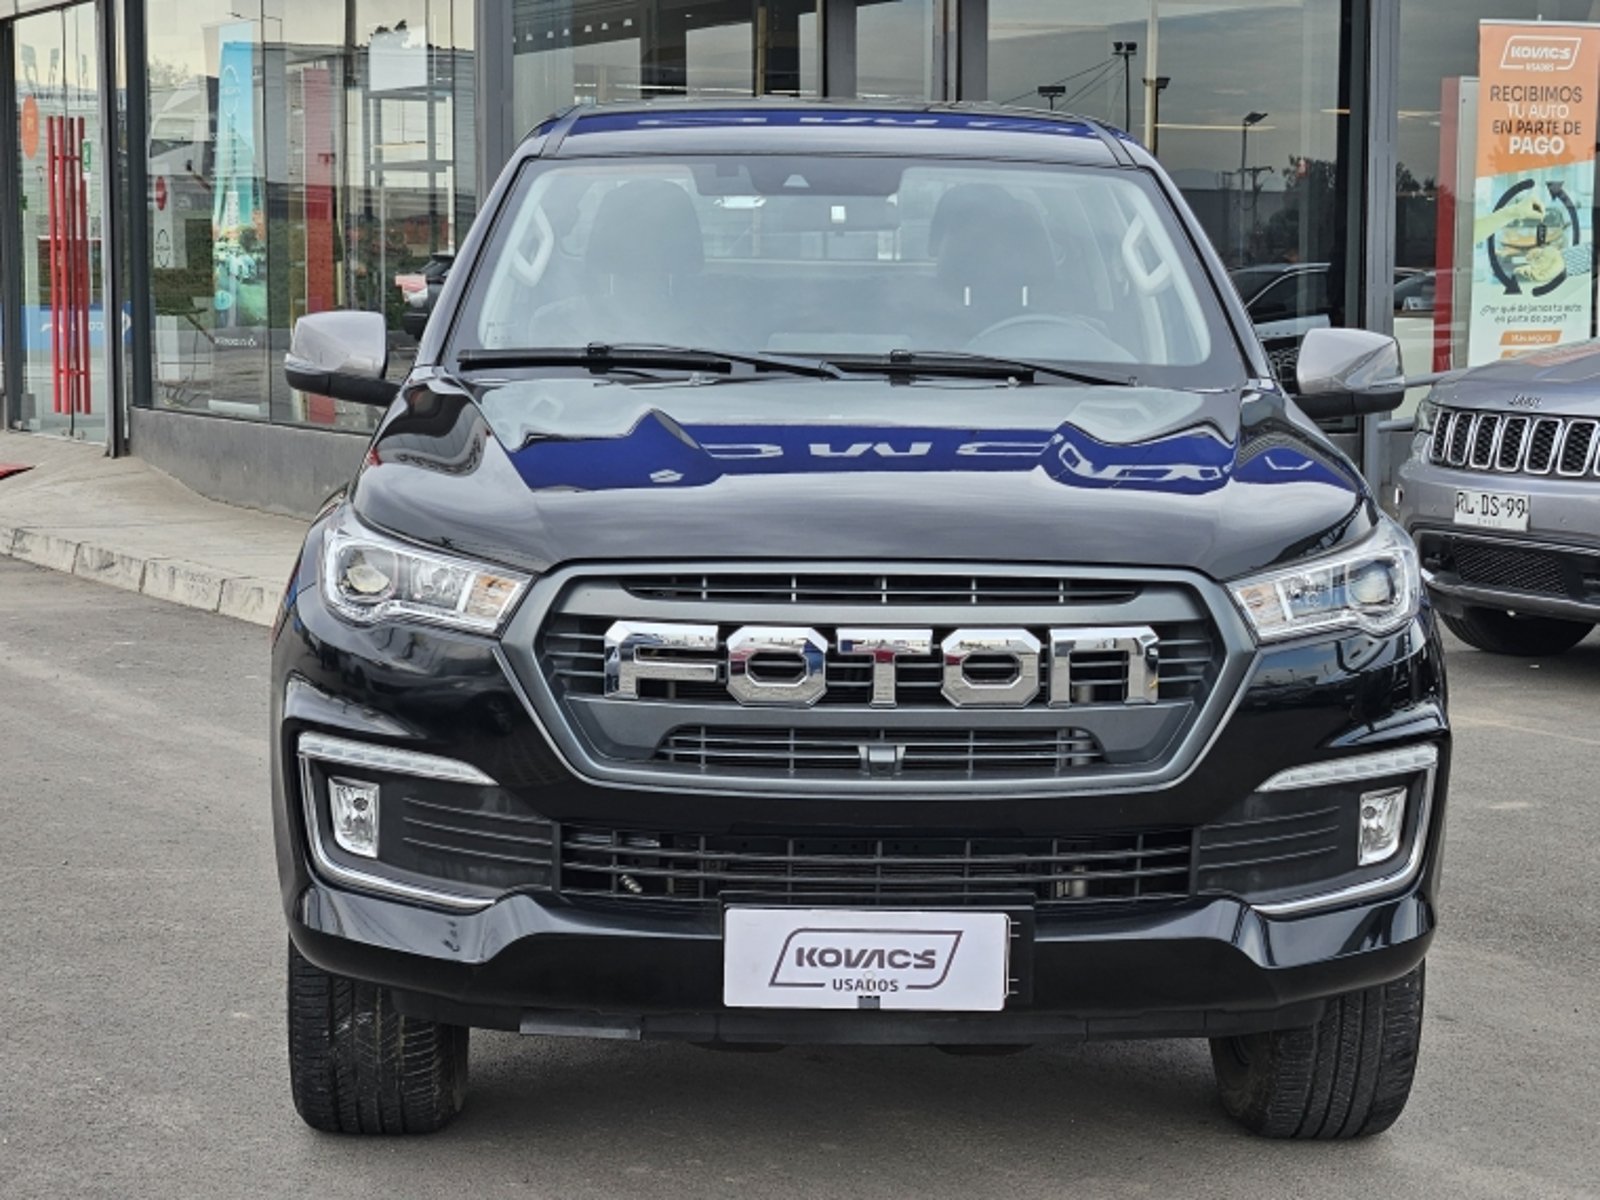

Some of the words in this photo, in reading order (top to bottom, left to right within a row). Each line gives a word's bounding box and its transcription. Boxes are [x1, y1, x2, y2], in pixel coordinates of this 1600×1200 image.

[1511, 46, 1571, 59] KOVACS
[1490, 85, 1582, 103] RECIBIMOS
[1508, 104, 1525, 118] TU
[1529, 104, 1569, 119] AUTO
[1492, 120, 1512, 134] EN
[1516, 120, 1559, 135] PARTE
[1563, 121, 1581, 135] DE
[1509, 136, 1565, 155] PAGO
[604, 620, 1160, 708] FOTON
[795, 947, 936, 969] KOVACS
[832, 978, 899, 992] USADOS
